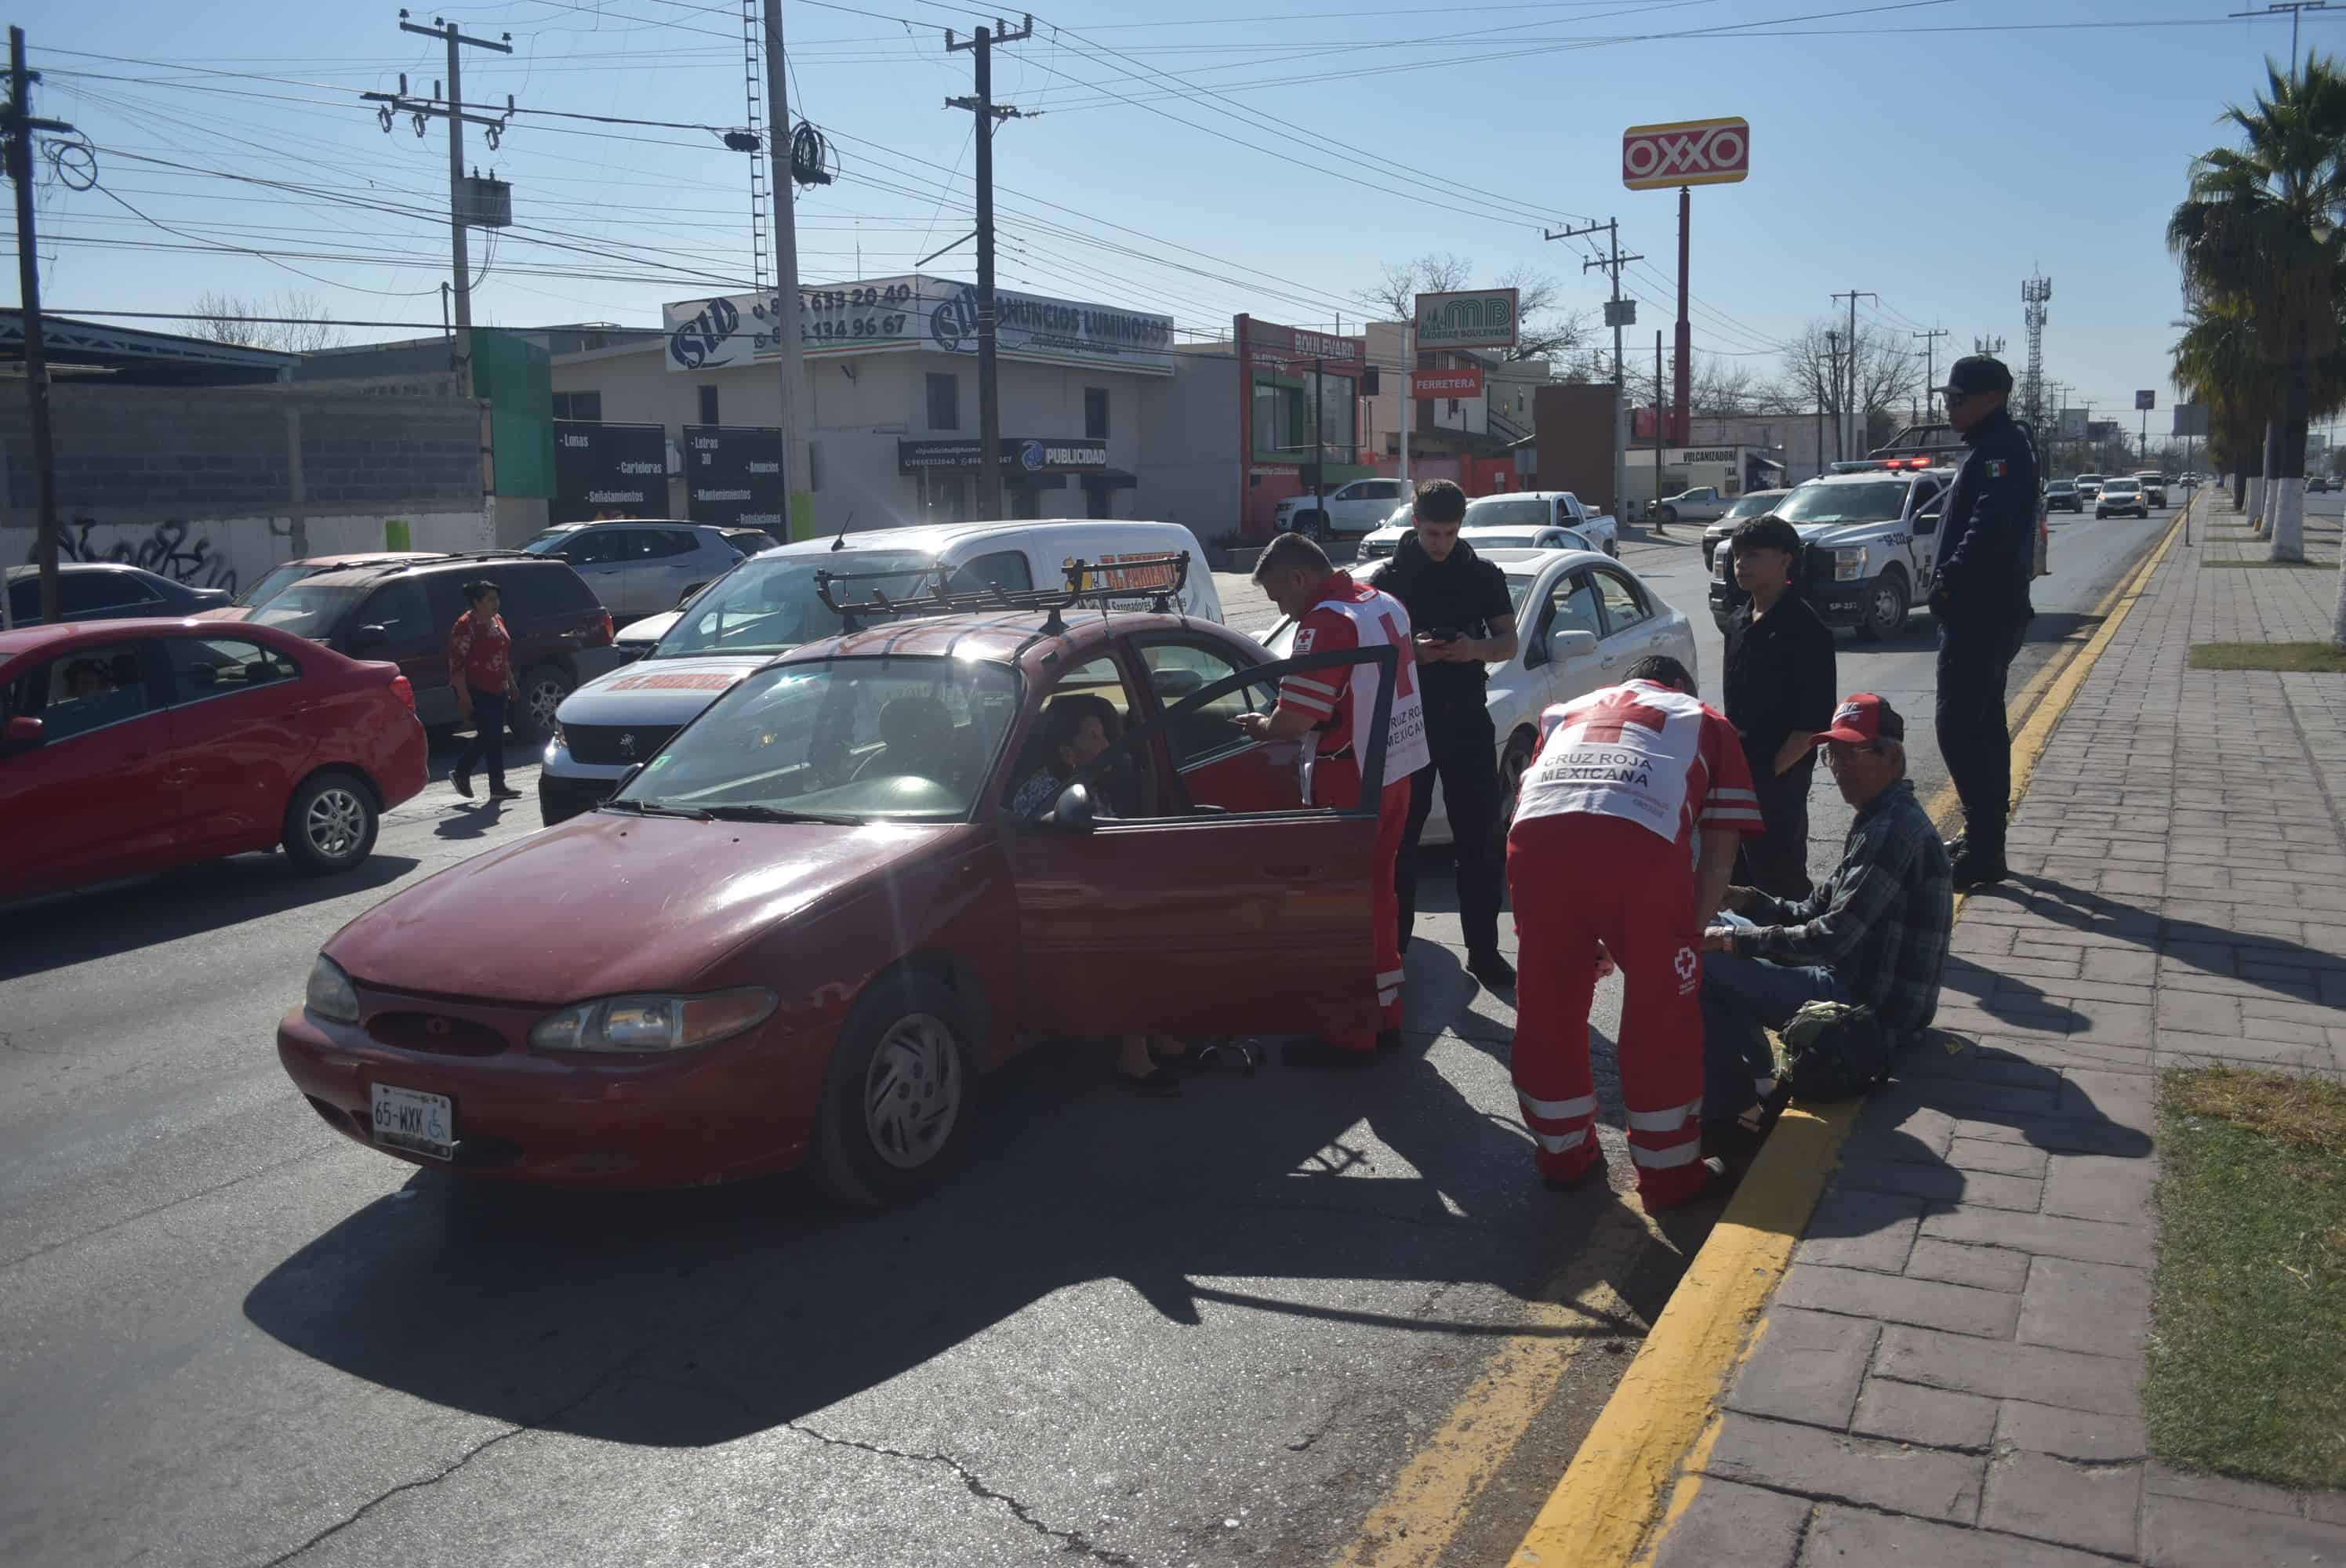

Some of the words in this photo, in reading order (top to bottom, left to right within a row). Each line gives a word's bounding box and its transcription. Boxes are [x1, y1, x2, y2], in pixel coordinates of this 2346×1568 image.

[1625, 128, 1744, 176] OXXO
[812, 290, 845, 312] 633
[852, 288, 877, 307] 20
[884, 283, 910, 303] 40
[813, 320, 847, 340] 134
[852, 317, 877, 336] 96
[883, 314, 907, 334] 67
[1084, 311, 1168, 342] LUMINOSOS
[1419, 330, 1460, 339] MADERAS
[1462, 327, 1511, 338] BOULEVARD
[1295, 333, 1355, 361] BOULEVARD
[1417, 378, 1476, 390] FERRETERA
[695, 437, 718, 448] Letras
[702, 453, 711, 465] 3D
[1045, 448, 1106, 465] PUBLICIDAD
[621, 461, 662, 474] Carteleras
[750, 461, 779, 473] Anuncios
[589, 491, 644, 503] Señalamientos
[698, 489, 751, 502] Mantenimientos
[740, 514, 781, 524] Rotulaciones
[1391, 712, 1407, 729] RUZ
[1544, 753, 1594, 767] CRUZ
[1599, 753, 1653, 771] ROJA
[1541, 768, 1648, 787] MEXICANA
